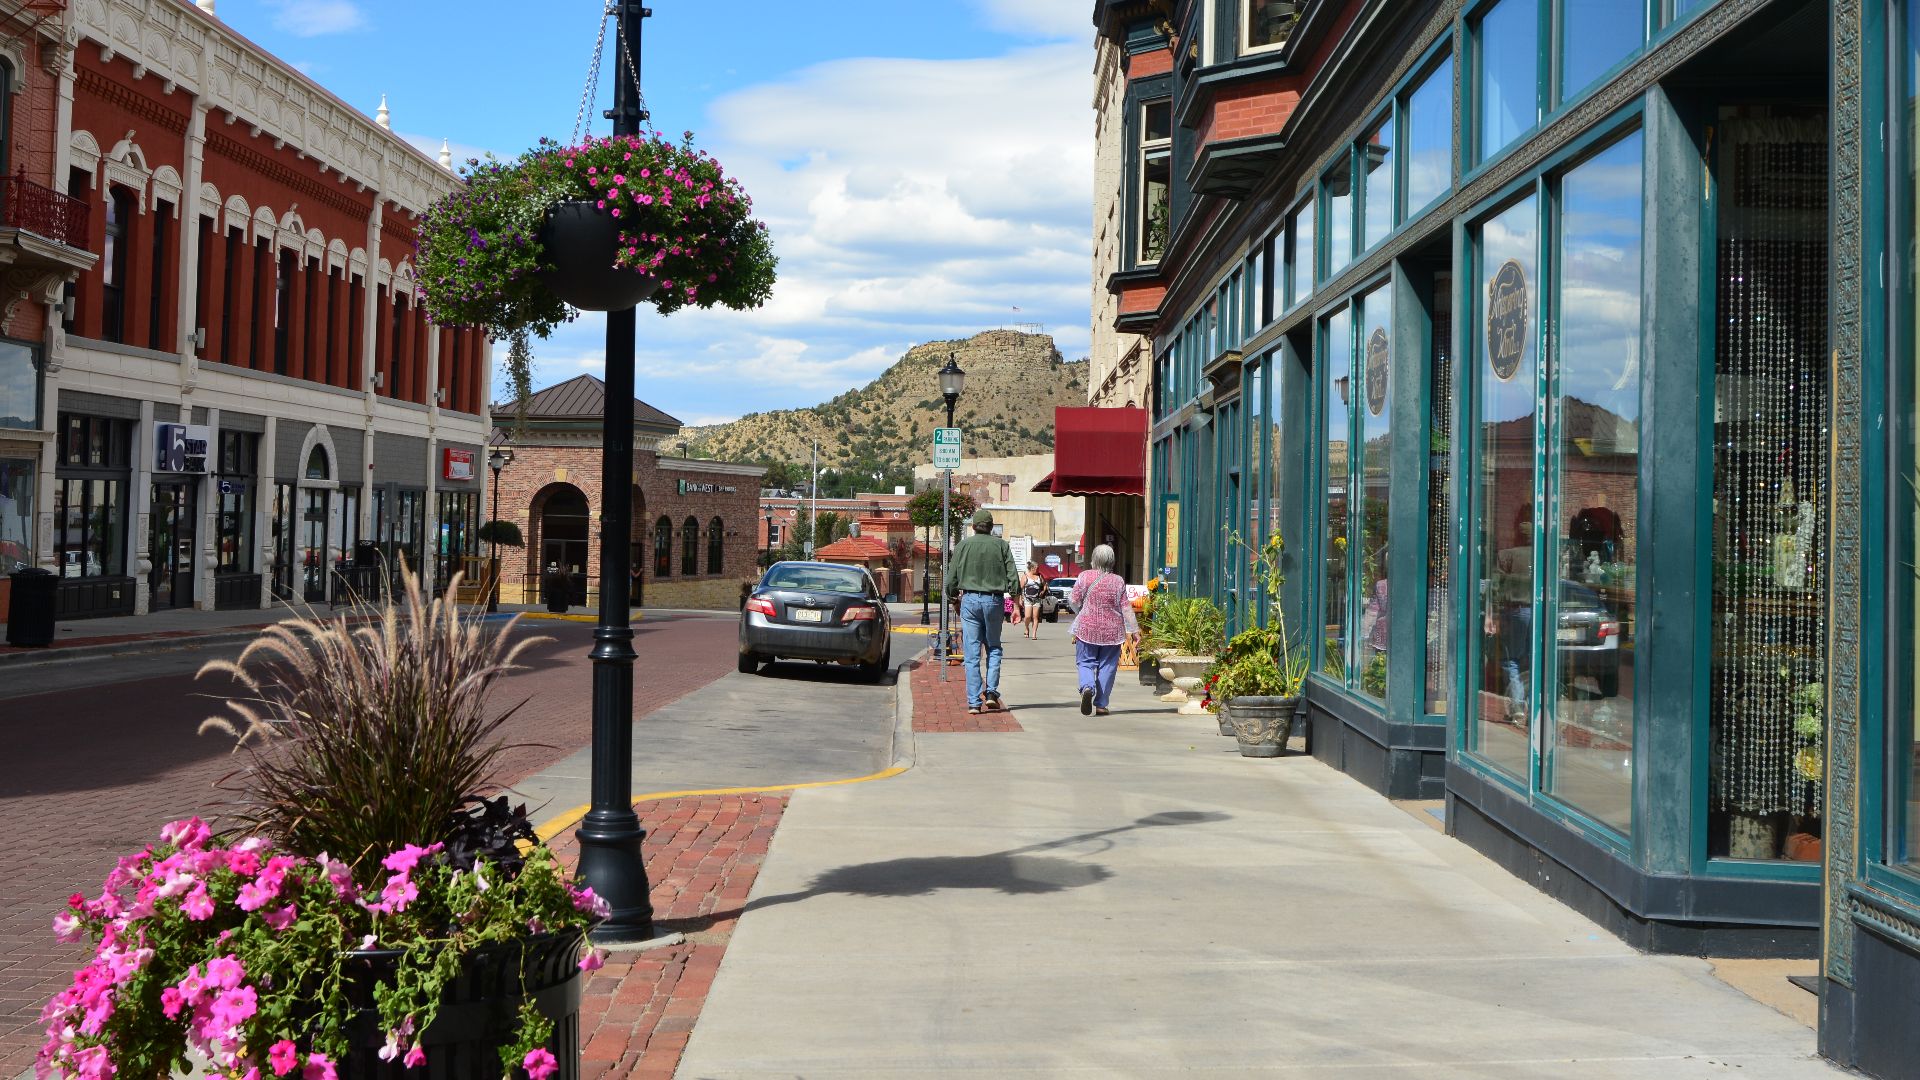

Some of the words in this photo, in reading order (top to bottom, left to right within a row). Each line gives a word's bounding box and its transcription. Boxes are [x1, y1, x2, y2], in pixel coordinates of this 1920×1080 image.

[936, 431, 942, 441] 2
[171, 427, 186, 472] 5
[185, 440, 208, 455] STAR
[221, 480, 231, 494] 5
[1165, 507, 1176, 564] OPEN
